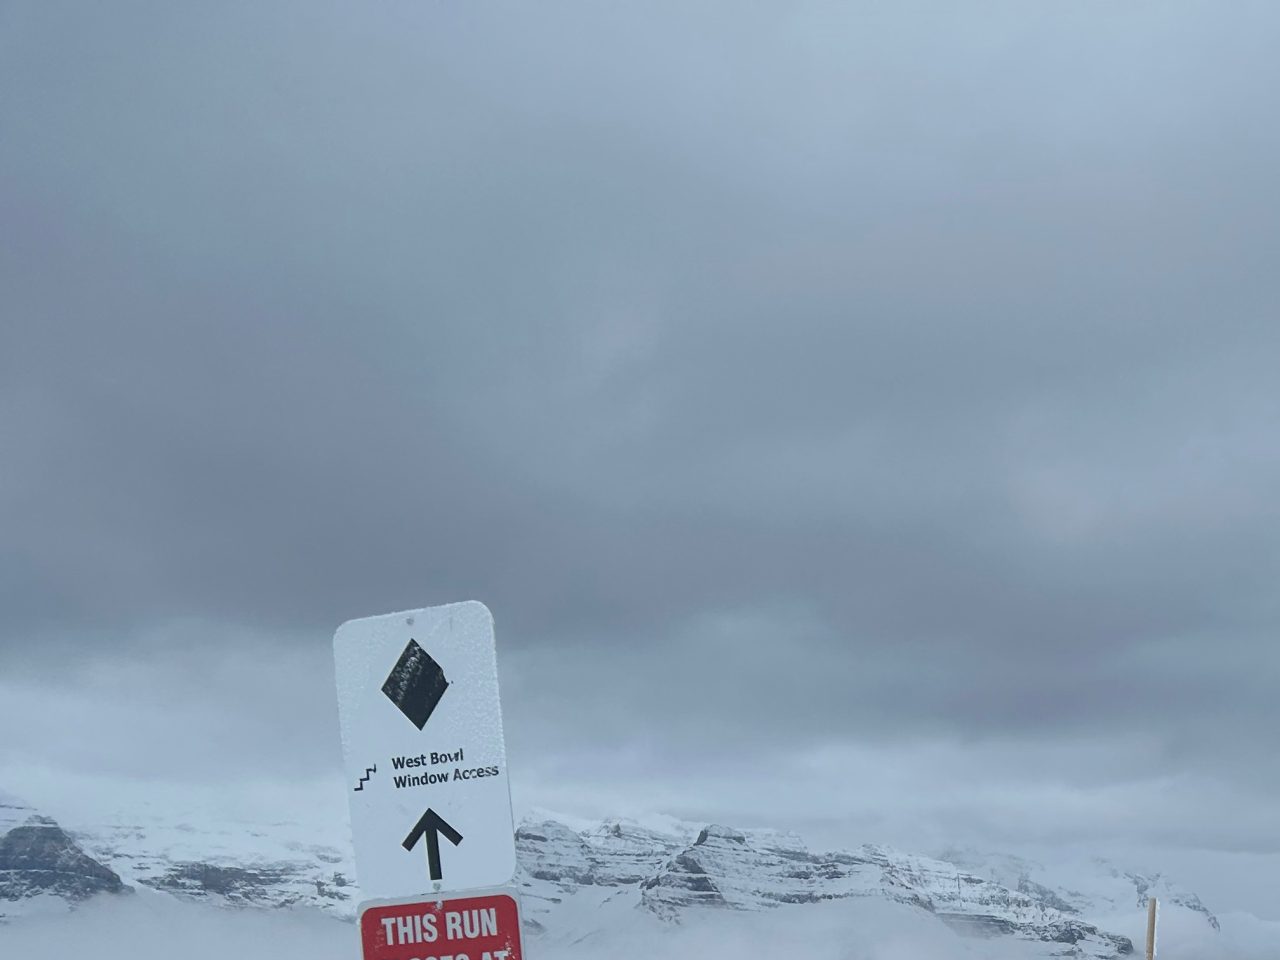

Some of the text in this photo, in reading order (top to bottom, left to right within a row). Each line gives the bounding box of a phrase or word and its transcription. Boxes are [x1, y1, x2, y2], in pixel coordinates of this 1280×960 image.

[392, 748, 464, 769] West Bowl
[394, 766, 499, 788] Window Access
[381, 908, 497, 946] THIS RUN
